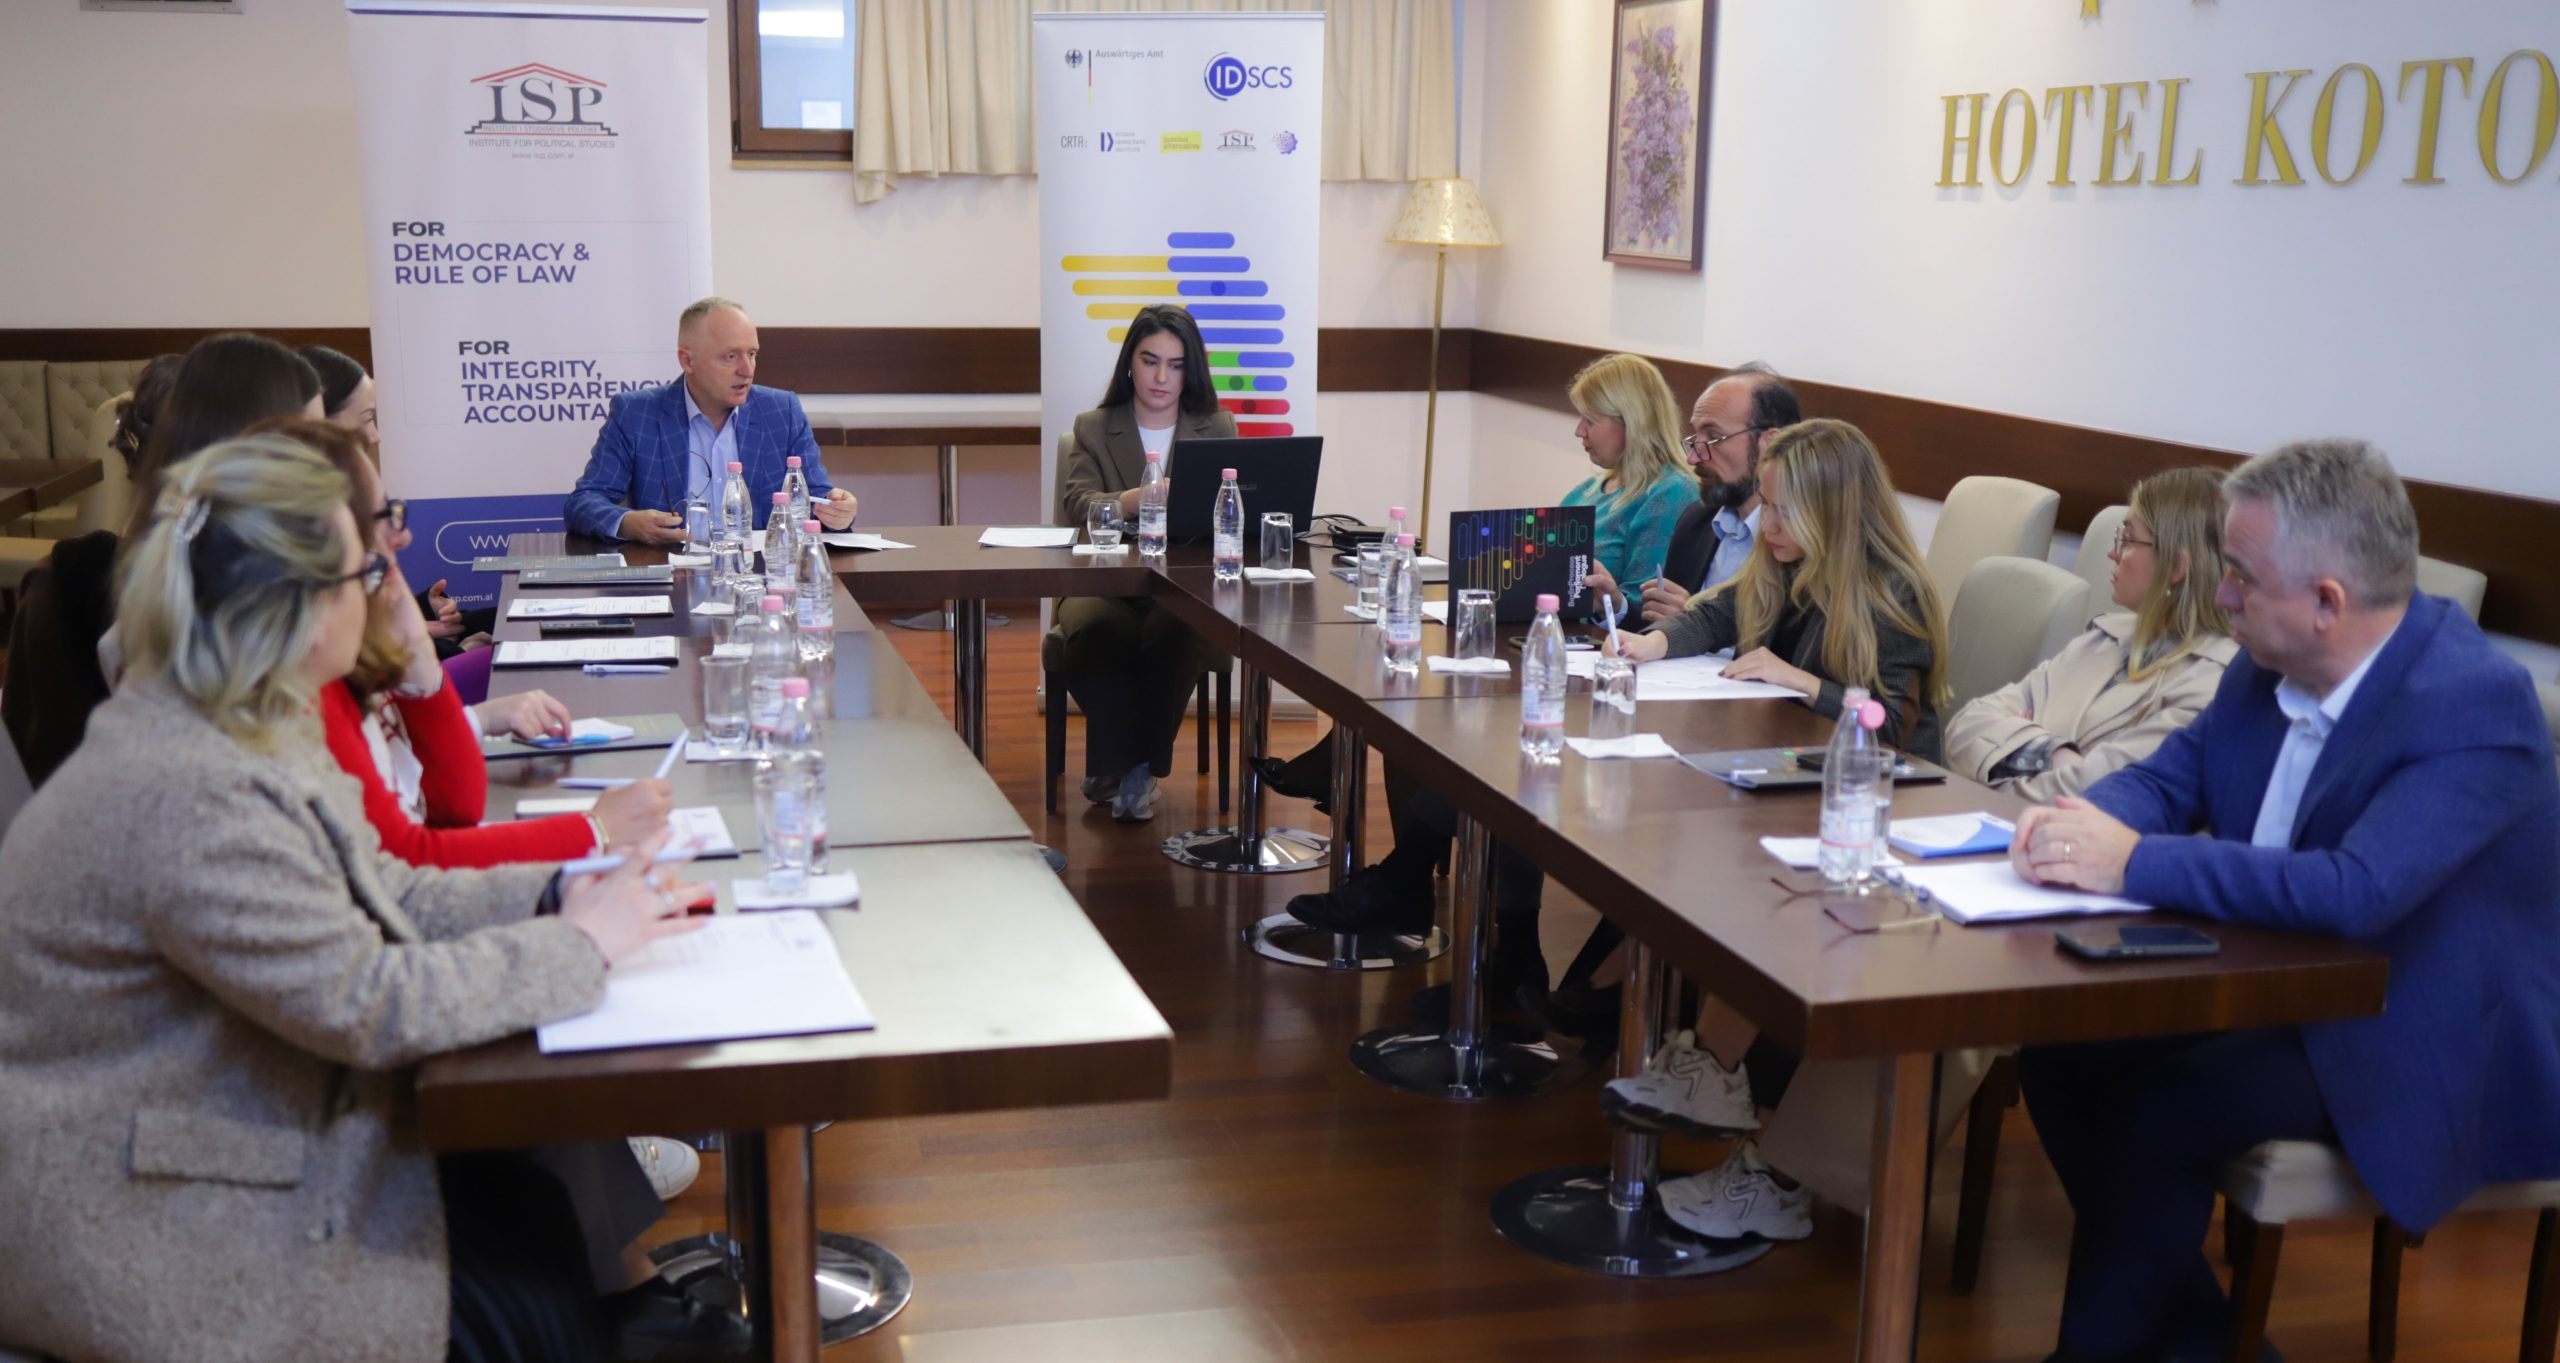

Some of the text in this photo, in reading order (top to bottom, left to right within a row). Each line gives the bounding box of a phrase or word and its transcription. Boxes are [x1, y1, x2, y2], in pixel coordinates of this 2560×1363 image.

[1095, 48, 1164, 60] Auswärtiges Amt
[1213, 64, 1293, 90] IDSCS
[485, 76, 604, 125] ISP
[1933, 47, 2560, 189] HOTEL KOTO
[469, 138, 616, 149] INSTITUTE FOR POLITICAL STUDIES
[1222, 133, 1254, 147] ISP
[391, 221, 445, 237] FOR
[393, 242, 590, 262] DEMOCRACY &
[394, 264, 577, 284] RULE OF LAW
[458, 340, 510, 355] FOR
[461, 359, 602, 381] INTEGRITY,
[461, 379, 673, 402] TRANSPAREN
[464, 403, 608, 424] ACCOUNTA
[448, 592, 493, 604] sp.com.al
